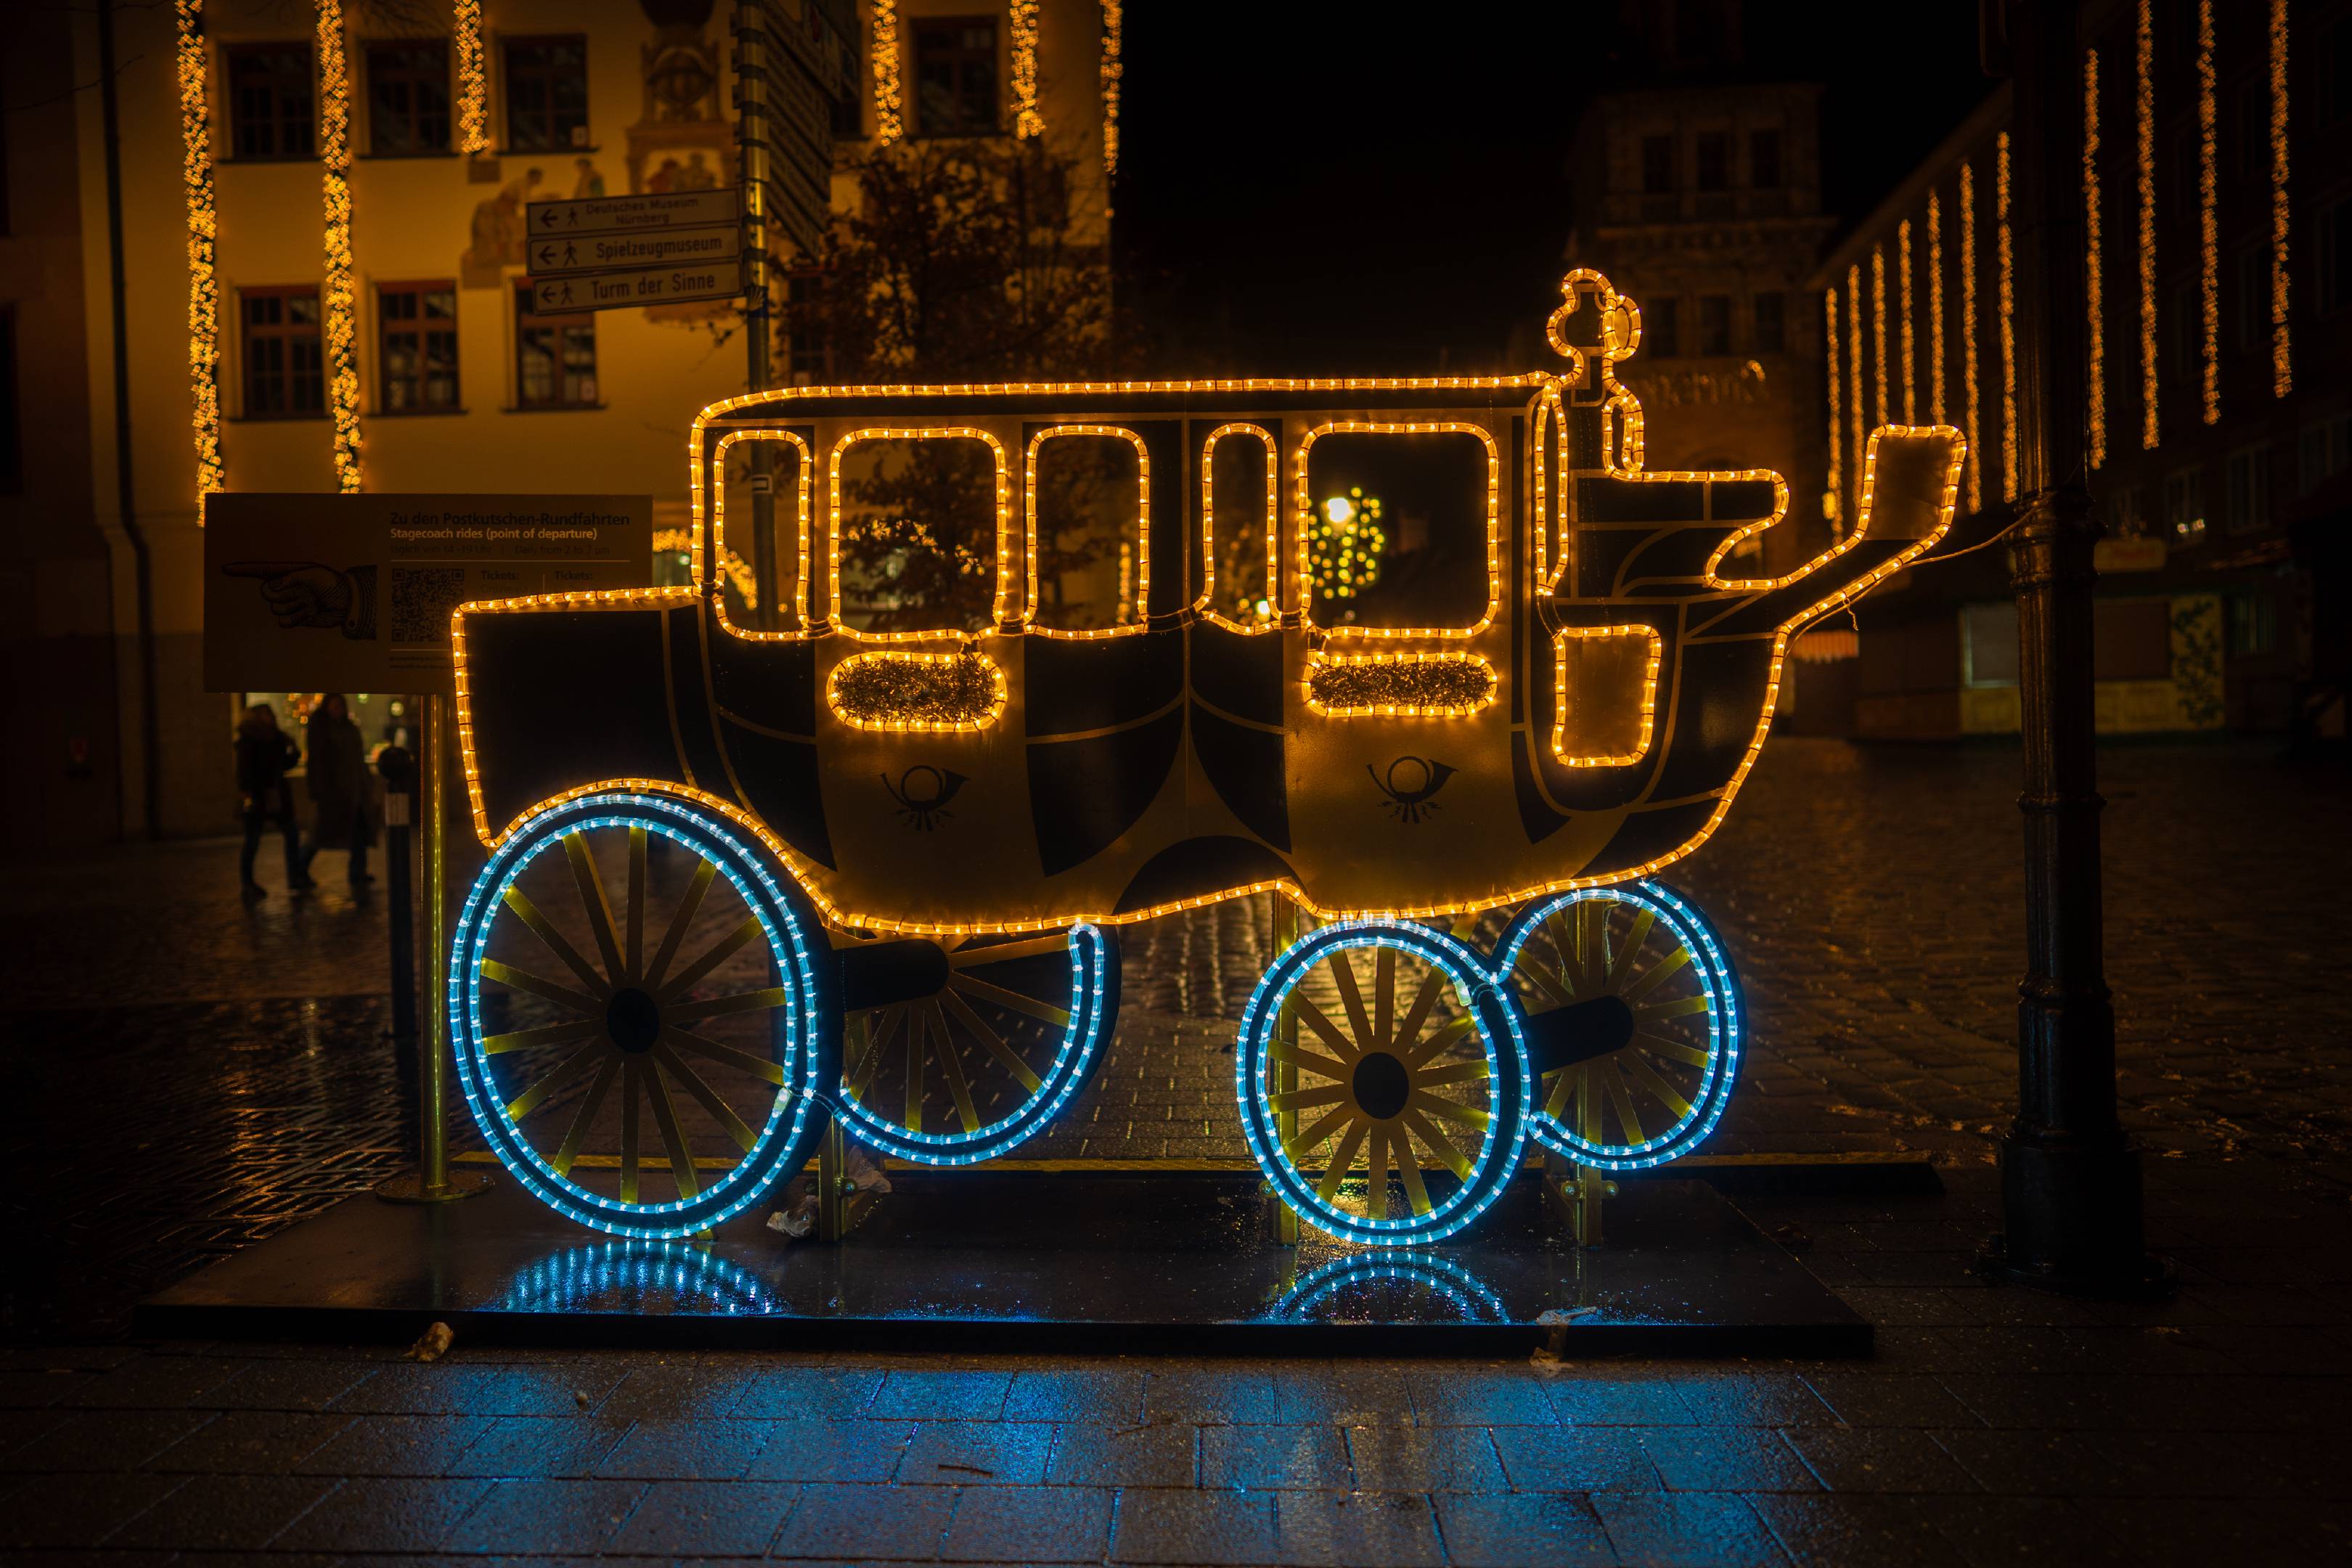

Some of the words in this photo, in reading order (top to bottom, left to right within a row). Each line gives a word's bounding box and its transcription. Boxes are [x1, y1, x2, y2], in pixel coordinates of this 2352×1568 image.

[587, 201, 645, 215] Deutsches
[650, 197, 699, 210] Museum
[616, 212, 670, 225] Nürnberg
[596, 237, 722, 262] Spielzeugmuseum
[591, 279, 630, 299] Turm
[638, 276, 663, 295] der
[671, 273, 715, 292] Sinne
[391, 512, 408, 525] Zu
[412, 511, 438, 525] den
[444, 511, 630, 526] Postkutschen-Rundfahrten
[391, 528, 453, 541] Stagecoach
[456, 528, 483, 539] rides
[486, 528, 520, 541] (point
[523, 528, 536, 539] of
[538, 528, 597, 541] departure)
[515, 545, 536, 556] Daily
[540, 545, 562, 554] from
[565, 545, 571, 554] 2
[595, 547, 610, 557] pm
[481, 569, 519, 581] Tickets:
[555, 569, 593, 581] Tickets:
